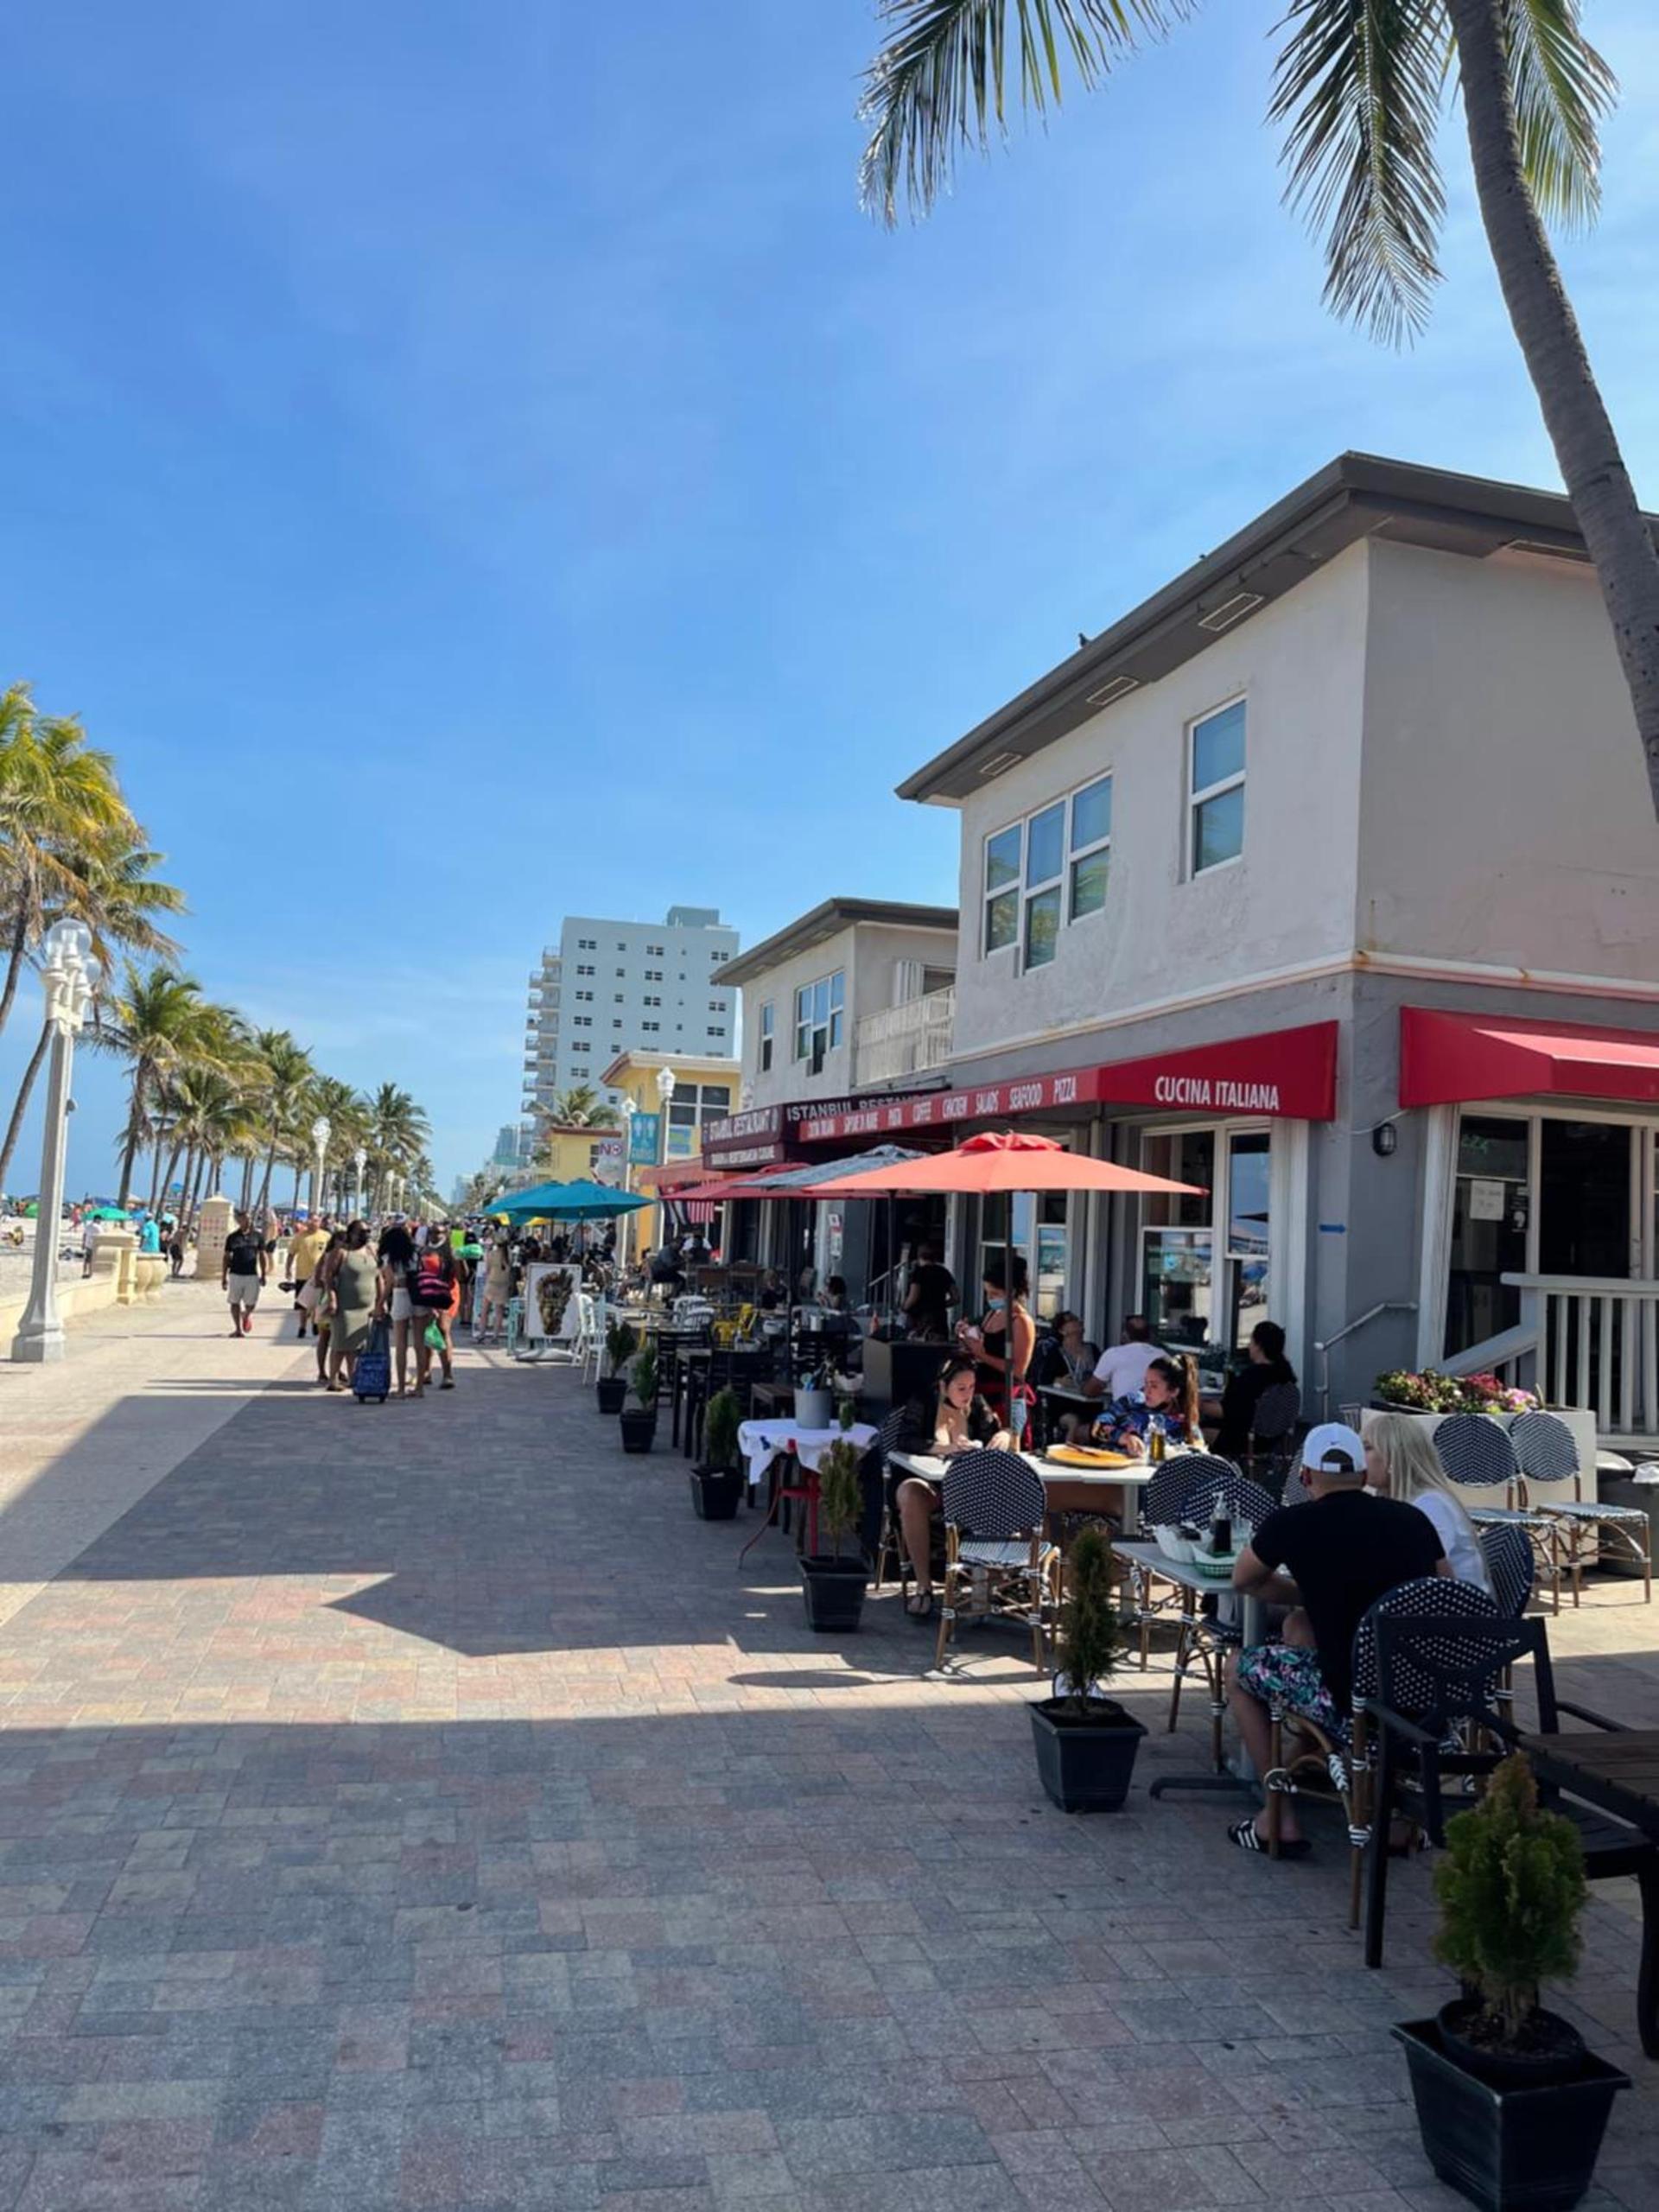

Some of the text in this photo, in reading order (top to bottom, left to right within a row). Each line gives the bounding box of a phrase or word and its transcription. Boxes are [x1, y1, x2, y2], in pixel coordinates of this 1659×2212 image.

[1053, 1076, 1077, 1105] PIZZA
[1154, 1076, 1280, 1110] CUCINA ITALIANA
